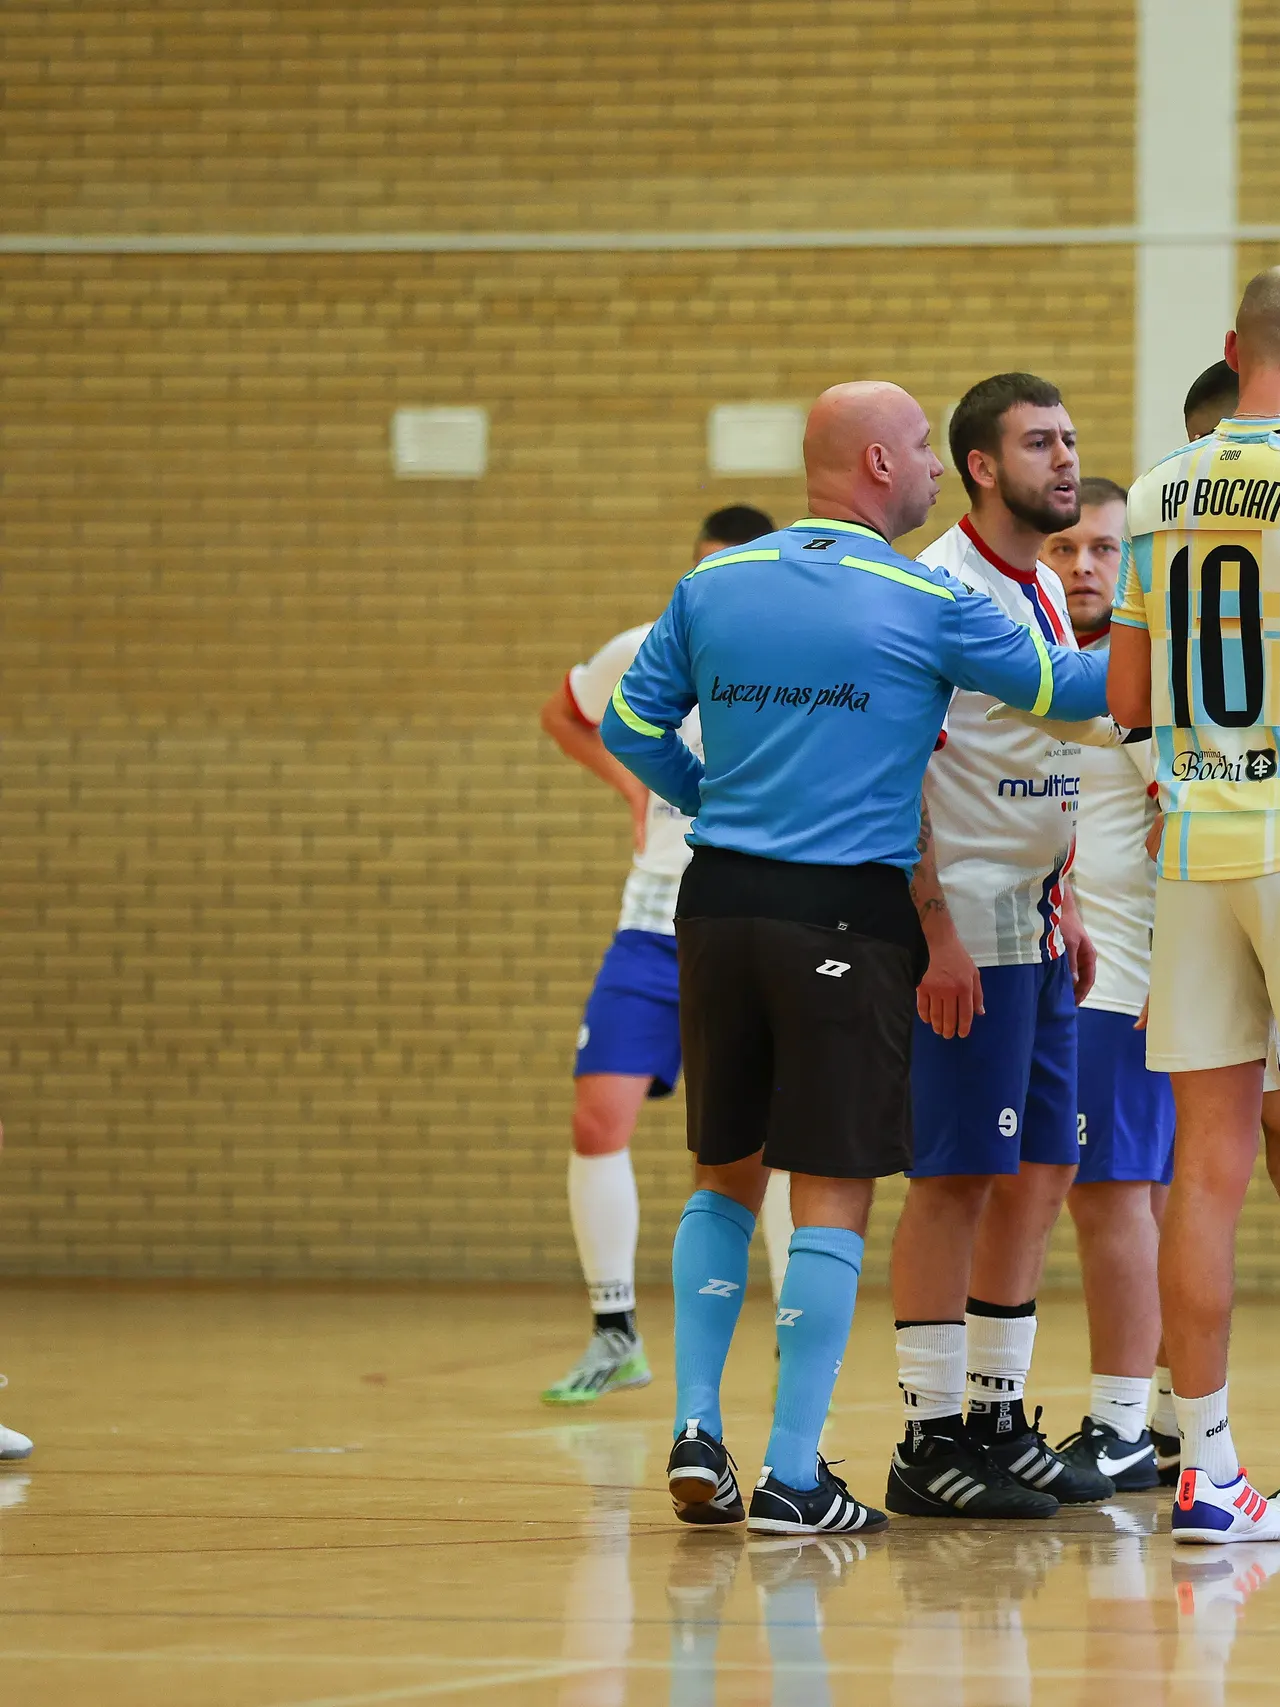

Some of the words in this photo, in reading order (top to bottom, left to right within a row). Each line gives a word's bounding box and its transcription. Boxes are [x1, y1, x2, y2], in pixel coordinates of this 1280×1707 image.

[1220, 450, 1241, 460] 2009
[1162, 479, 1189, 522] KP
[1170, 545, 1264, 728] 10
[711, 676, 772, 713] Łączy
[773, 686, 812, 708] nas
[807, 683, 870, 716] piłka
[998, 1107, 1018, 1137] 9
